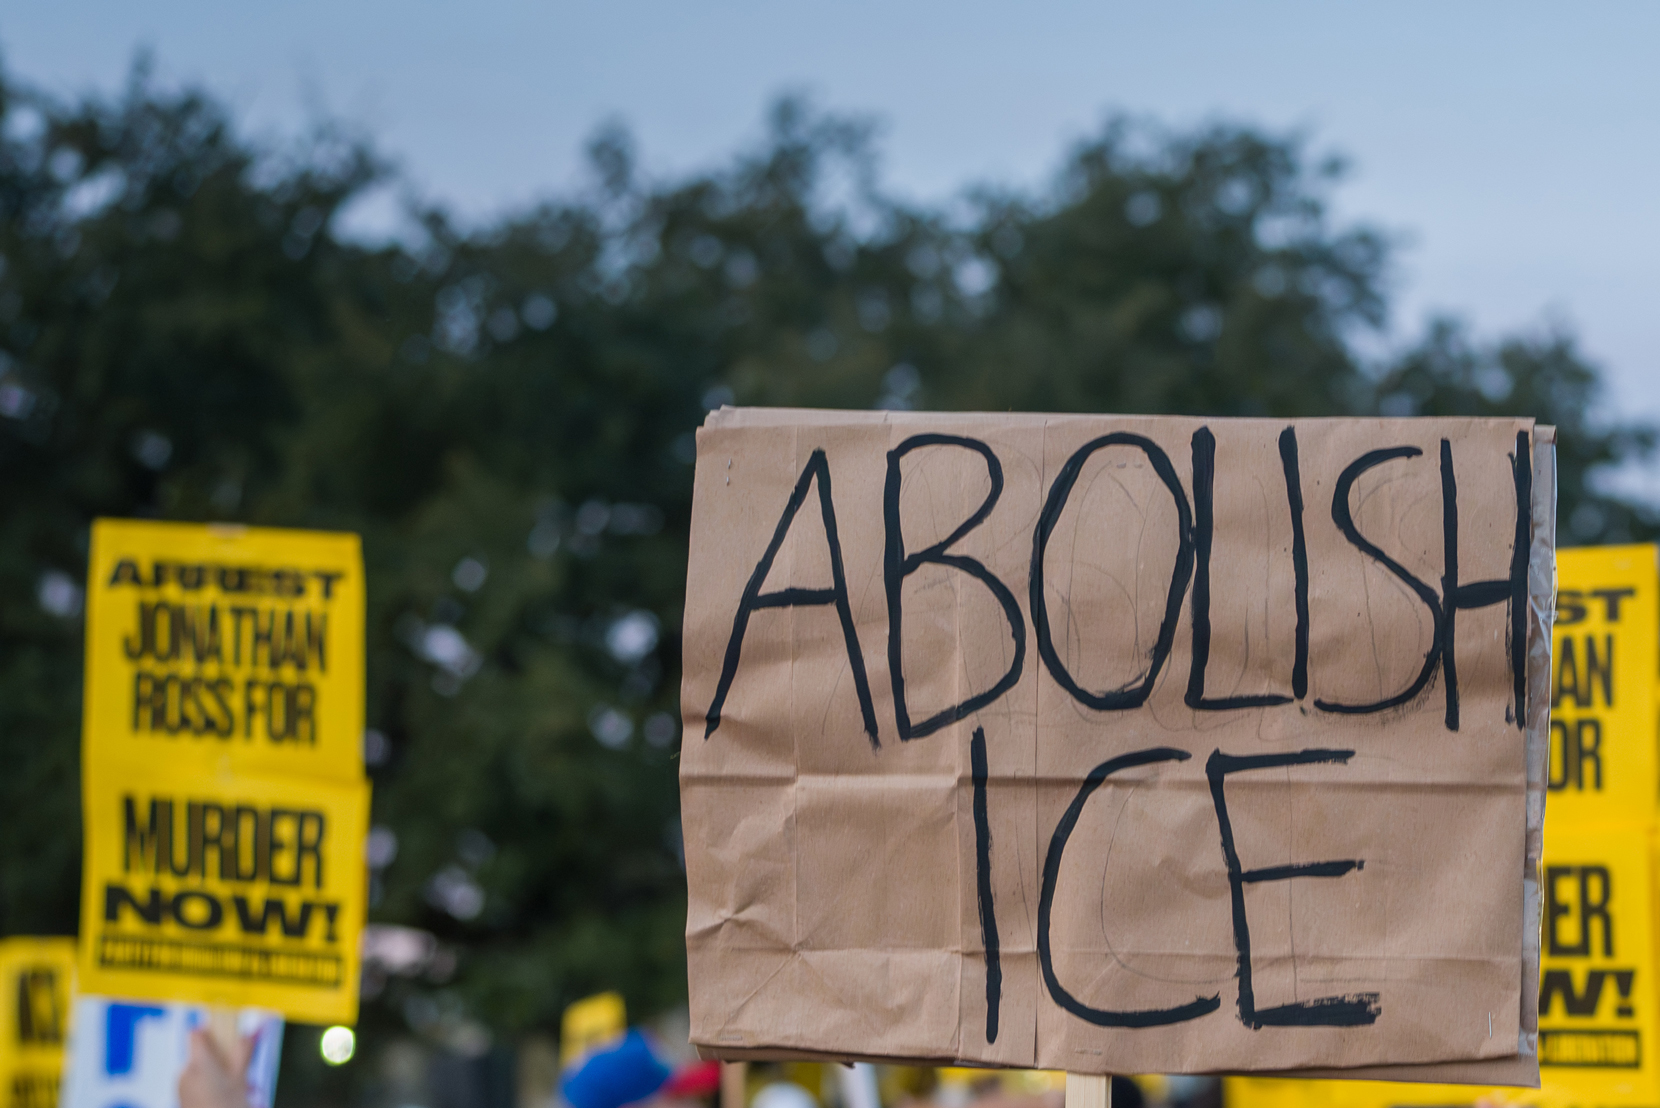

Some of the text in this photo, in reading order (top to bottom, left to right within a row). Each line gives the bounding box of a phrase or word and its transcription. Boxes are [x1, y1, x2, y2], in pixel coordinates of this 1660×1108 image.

[704, 424, 1534, 750] ABOLISH
[123, 600, 328, 678] JONATHAN
[132, 669, 317, 748] ROSS FOR
[1547, 717, 1604, 794] OR
[122, 796, 327, 890] MURDER
[104, 884, 340, 943] NOW!
[969, 726, 1382, 1045] ICE
